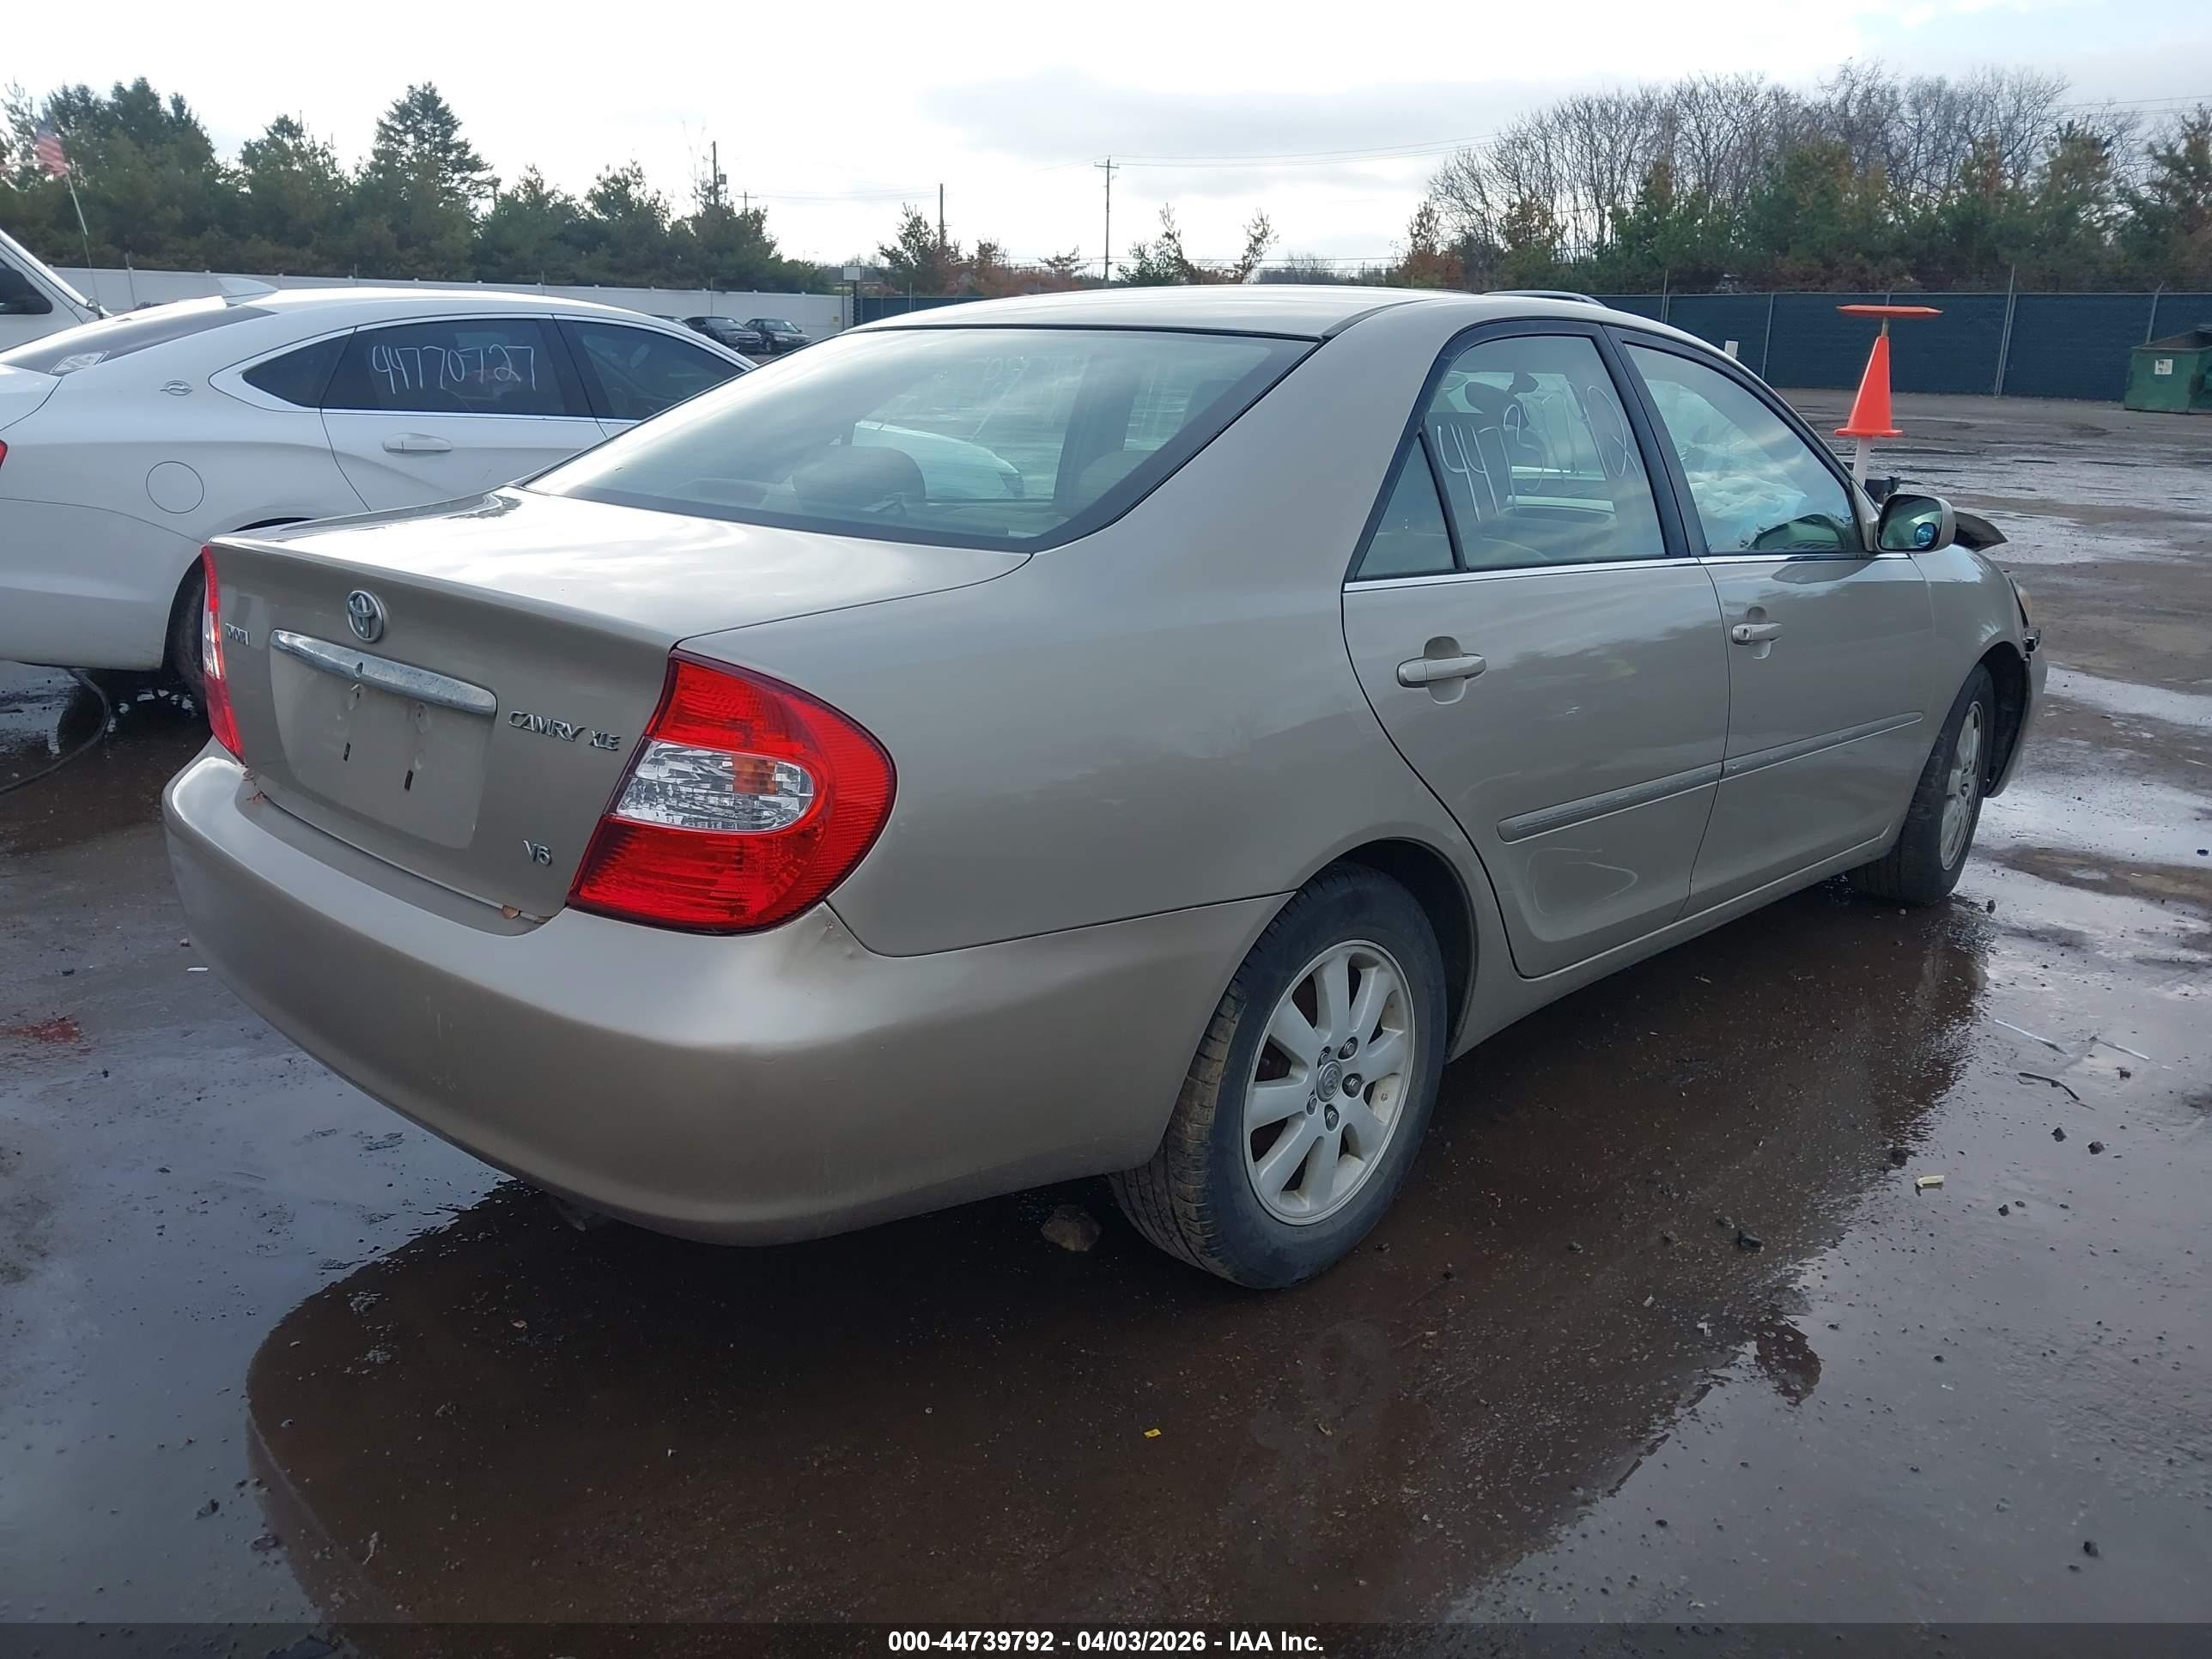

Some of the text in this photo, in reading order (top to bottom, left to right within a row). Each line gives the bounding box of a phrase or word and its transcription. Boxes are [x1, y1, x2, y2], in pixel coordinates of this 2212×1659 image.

[372, 343, 537, 395] 44770727
[508, 710, 621, 751] CAMRY XLE
[523, 839, 551, 866] V6
